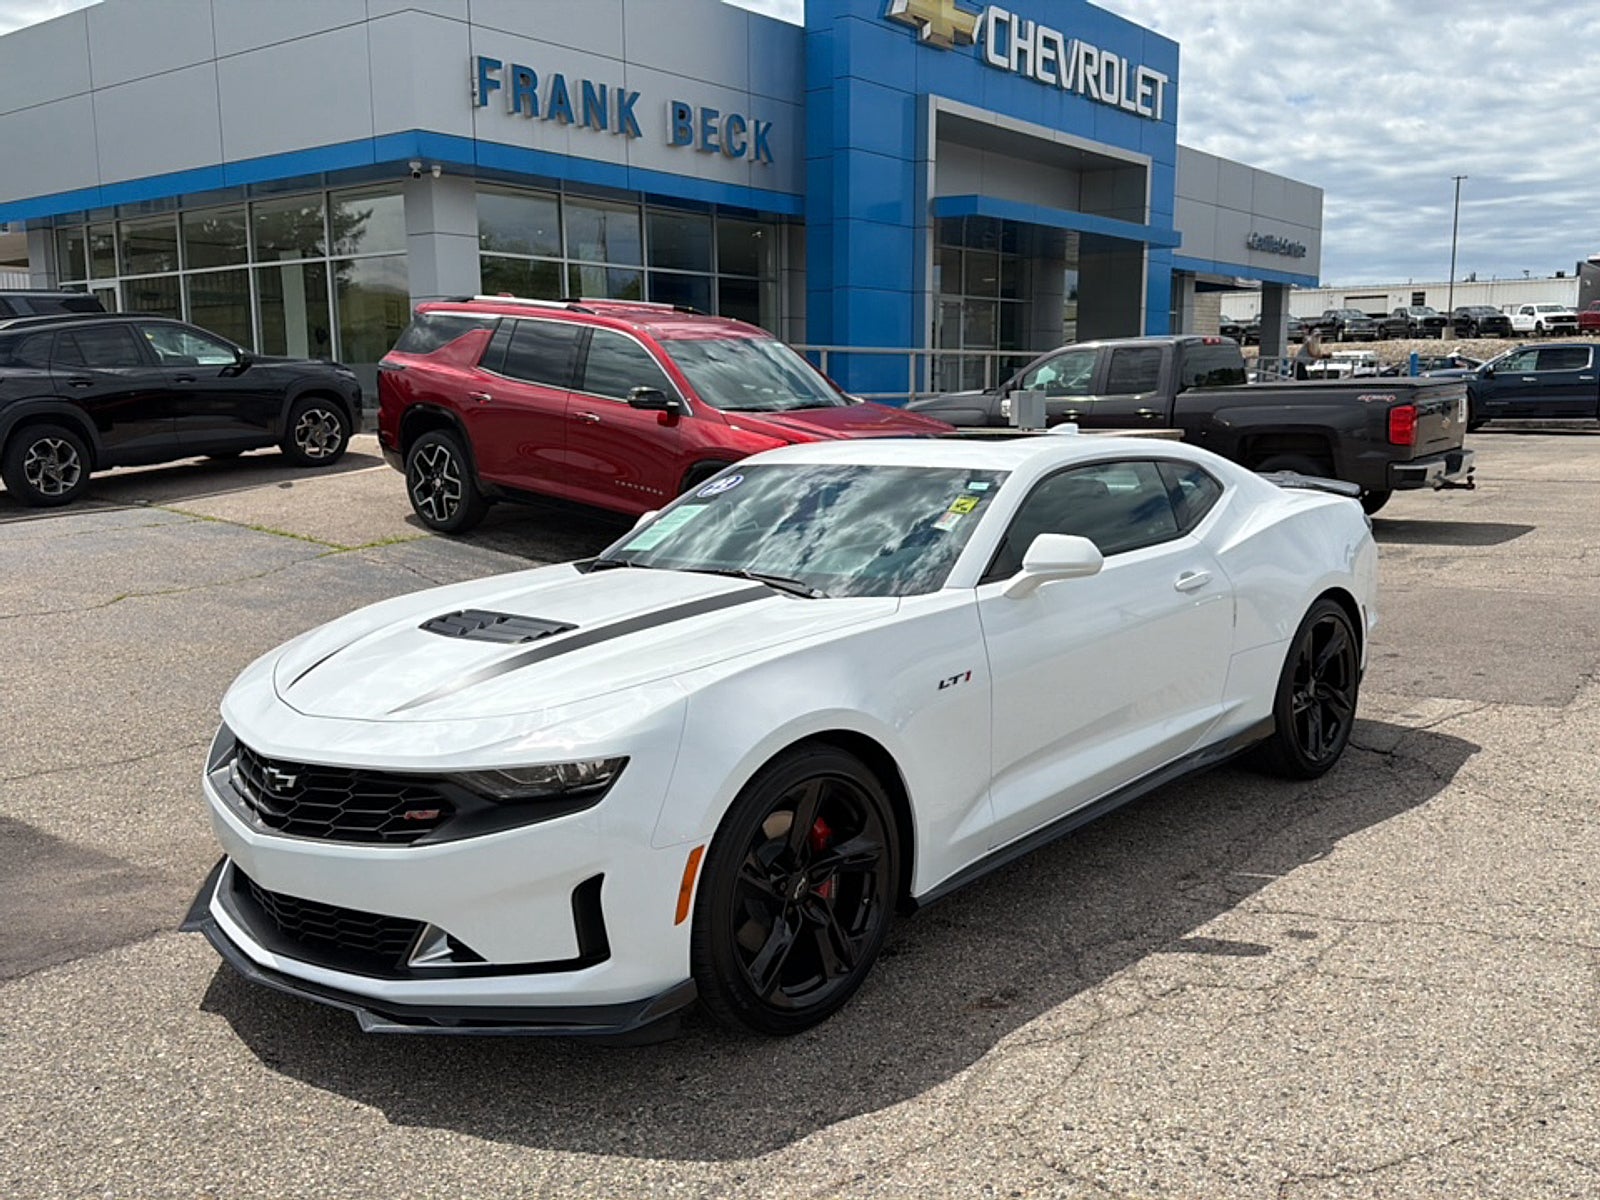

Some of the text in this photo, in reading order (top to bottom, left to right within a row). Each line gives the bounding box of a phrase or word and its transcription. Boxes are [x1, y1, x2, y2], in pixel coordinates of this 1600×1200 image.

[472, 55, 774, 164] FRANK BECK
[985, 5, 1168, 120] CHEVROLET
[938, 669, 972, 690] LT1
